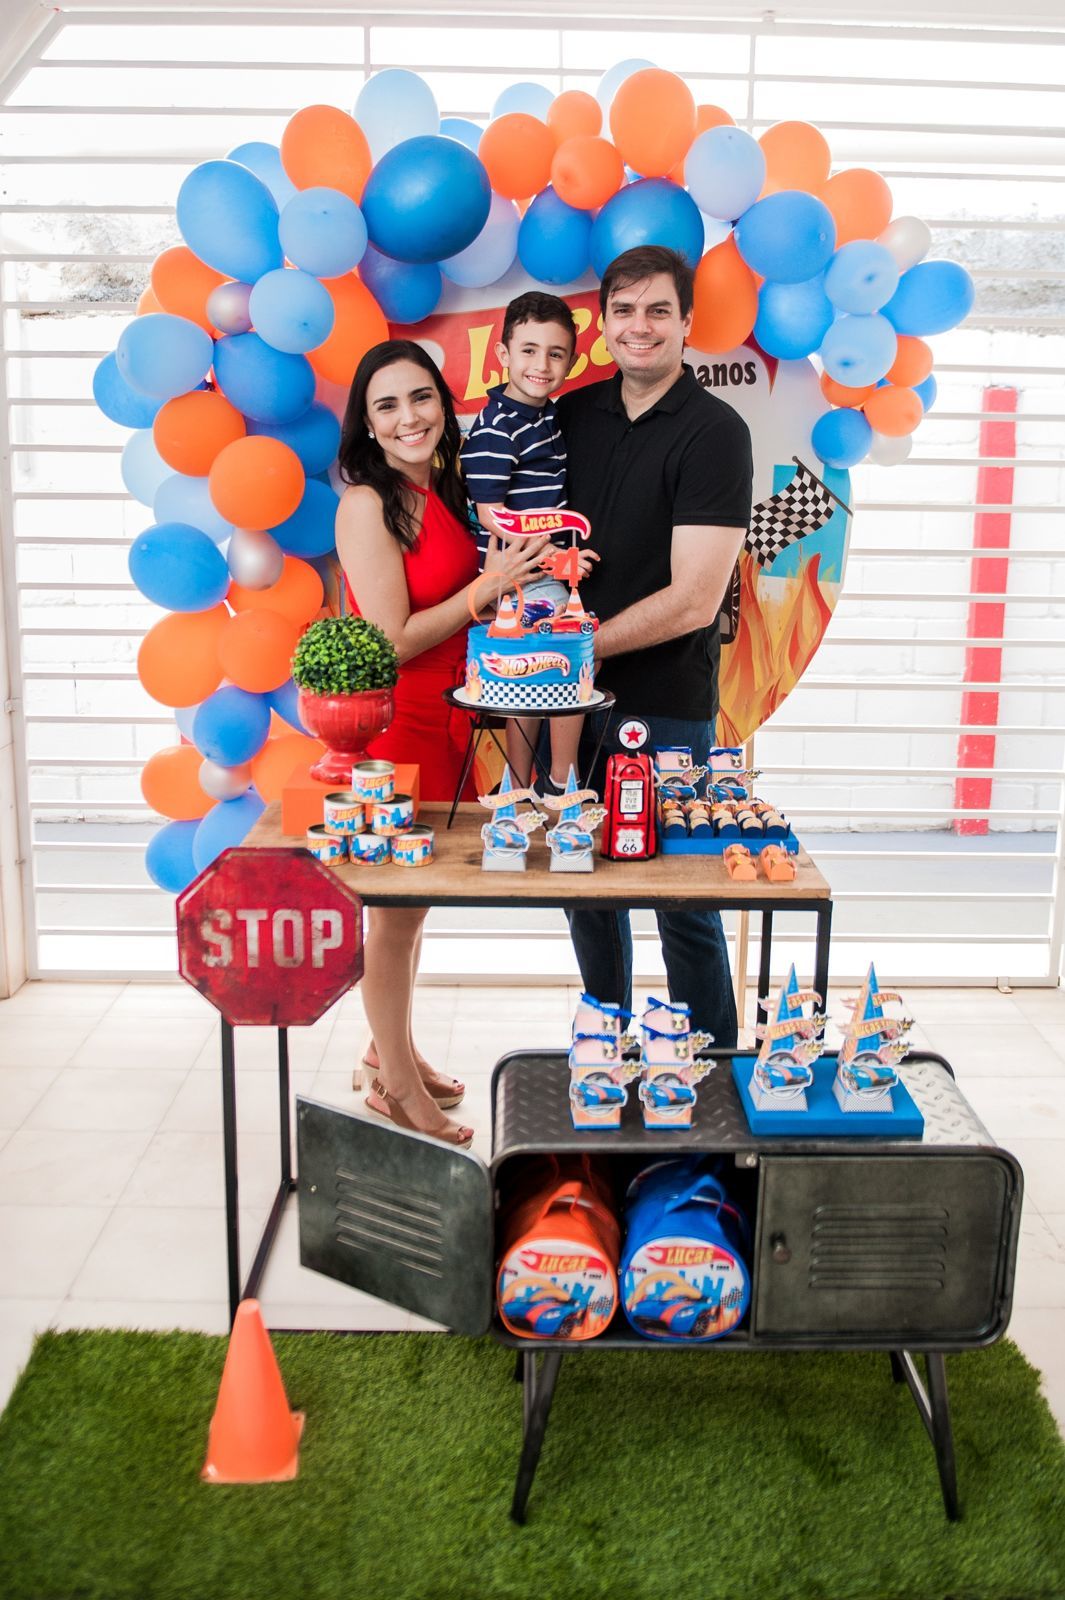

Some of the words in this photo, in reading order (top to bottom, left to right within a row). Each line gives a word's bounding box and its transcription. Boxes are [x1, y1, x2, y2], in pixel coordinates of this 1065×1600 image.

[519, 514, 563, 532] Lucas
[622, 843, 637, 852] 66
[201, 909, 343, 968] STOP
